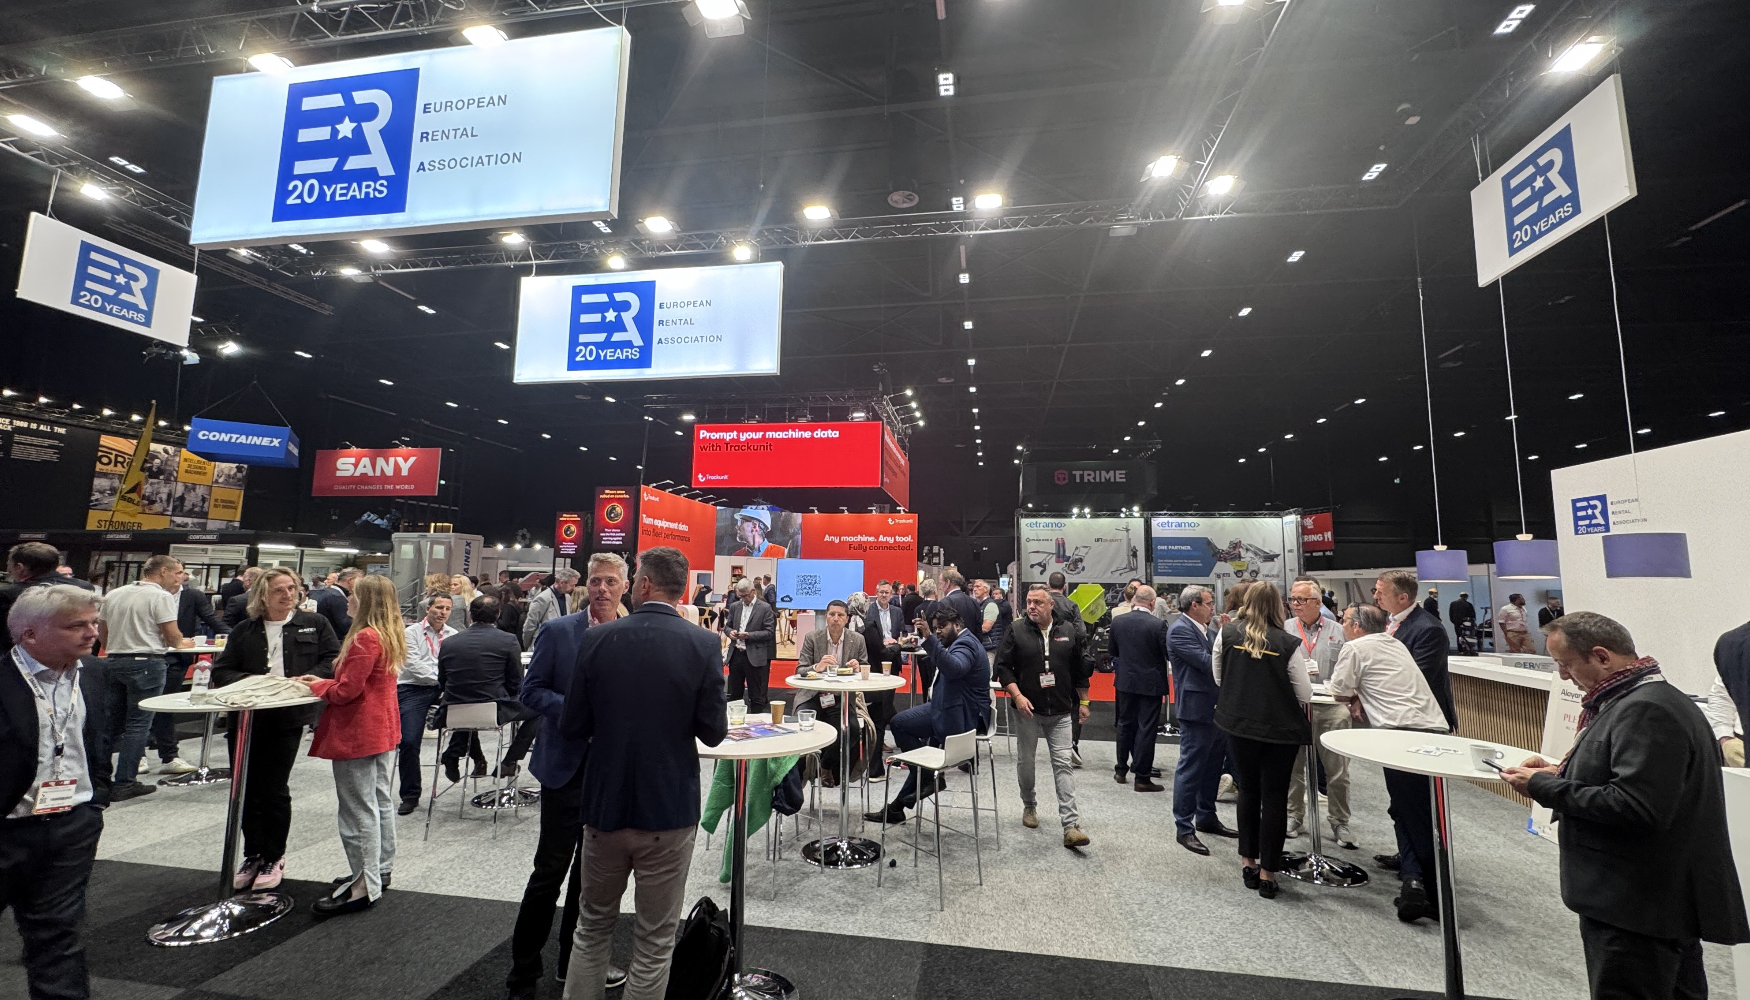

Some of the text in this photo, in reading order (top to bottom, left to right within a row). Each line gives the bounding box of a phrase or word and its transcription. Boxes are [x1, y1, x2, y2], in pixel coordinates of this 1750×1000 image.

[422, 94, 508, 114] EUROPEAN
[420, 126, 478, 142] RENTAL
[416, 152, 522, 173] ASSOCIATION
[286, 178, 388, 205] 20 YEARS
[1512, 202, 1573, 248] 20 YEARS
[78, 291, 146, 322] 20 YEARS
[659, 299, 712, 310] EUROPEAN
[658, 318, 694, 327] RENTAL
[656, 334, 722, 345] ASSOCIATION
[575, 345, 640, 361] 20 YEARS
[54, 426, 66, 434] THE
[700, 428, 840, 441] Prompt your machine data
[197, 430, 282, 447] CONTAINEX
[700, 442, 773, 452] with Trackunit
[335, 456, 417, 476] SANY
[1072, 470, 1126, 482] TRIME
[642, 514, 688, 532] Turn equipment data
[642, 527, 690, 542] into fleet performance
[824, 534, 839, 543] Any
[878, 534, 894, 543] Any
[848, 544, 867, 552] Fully
